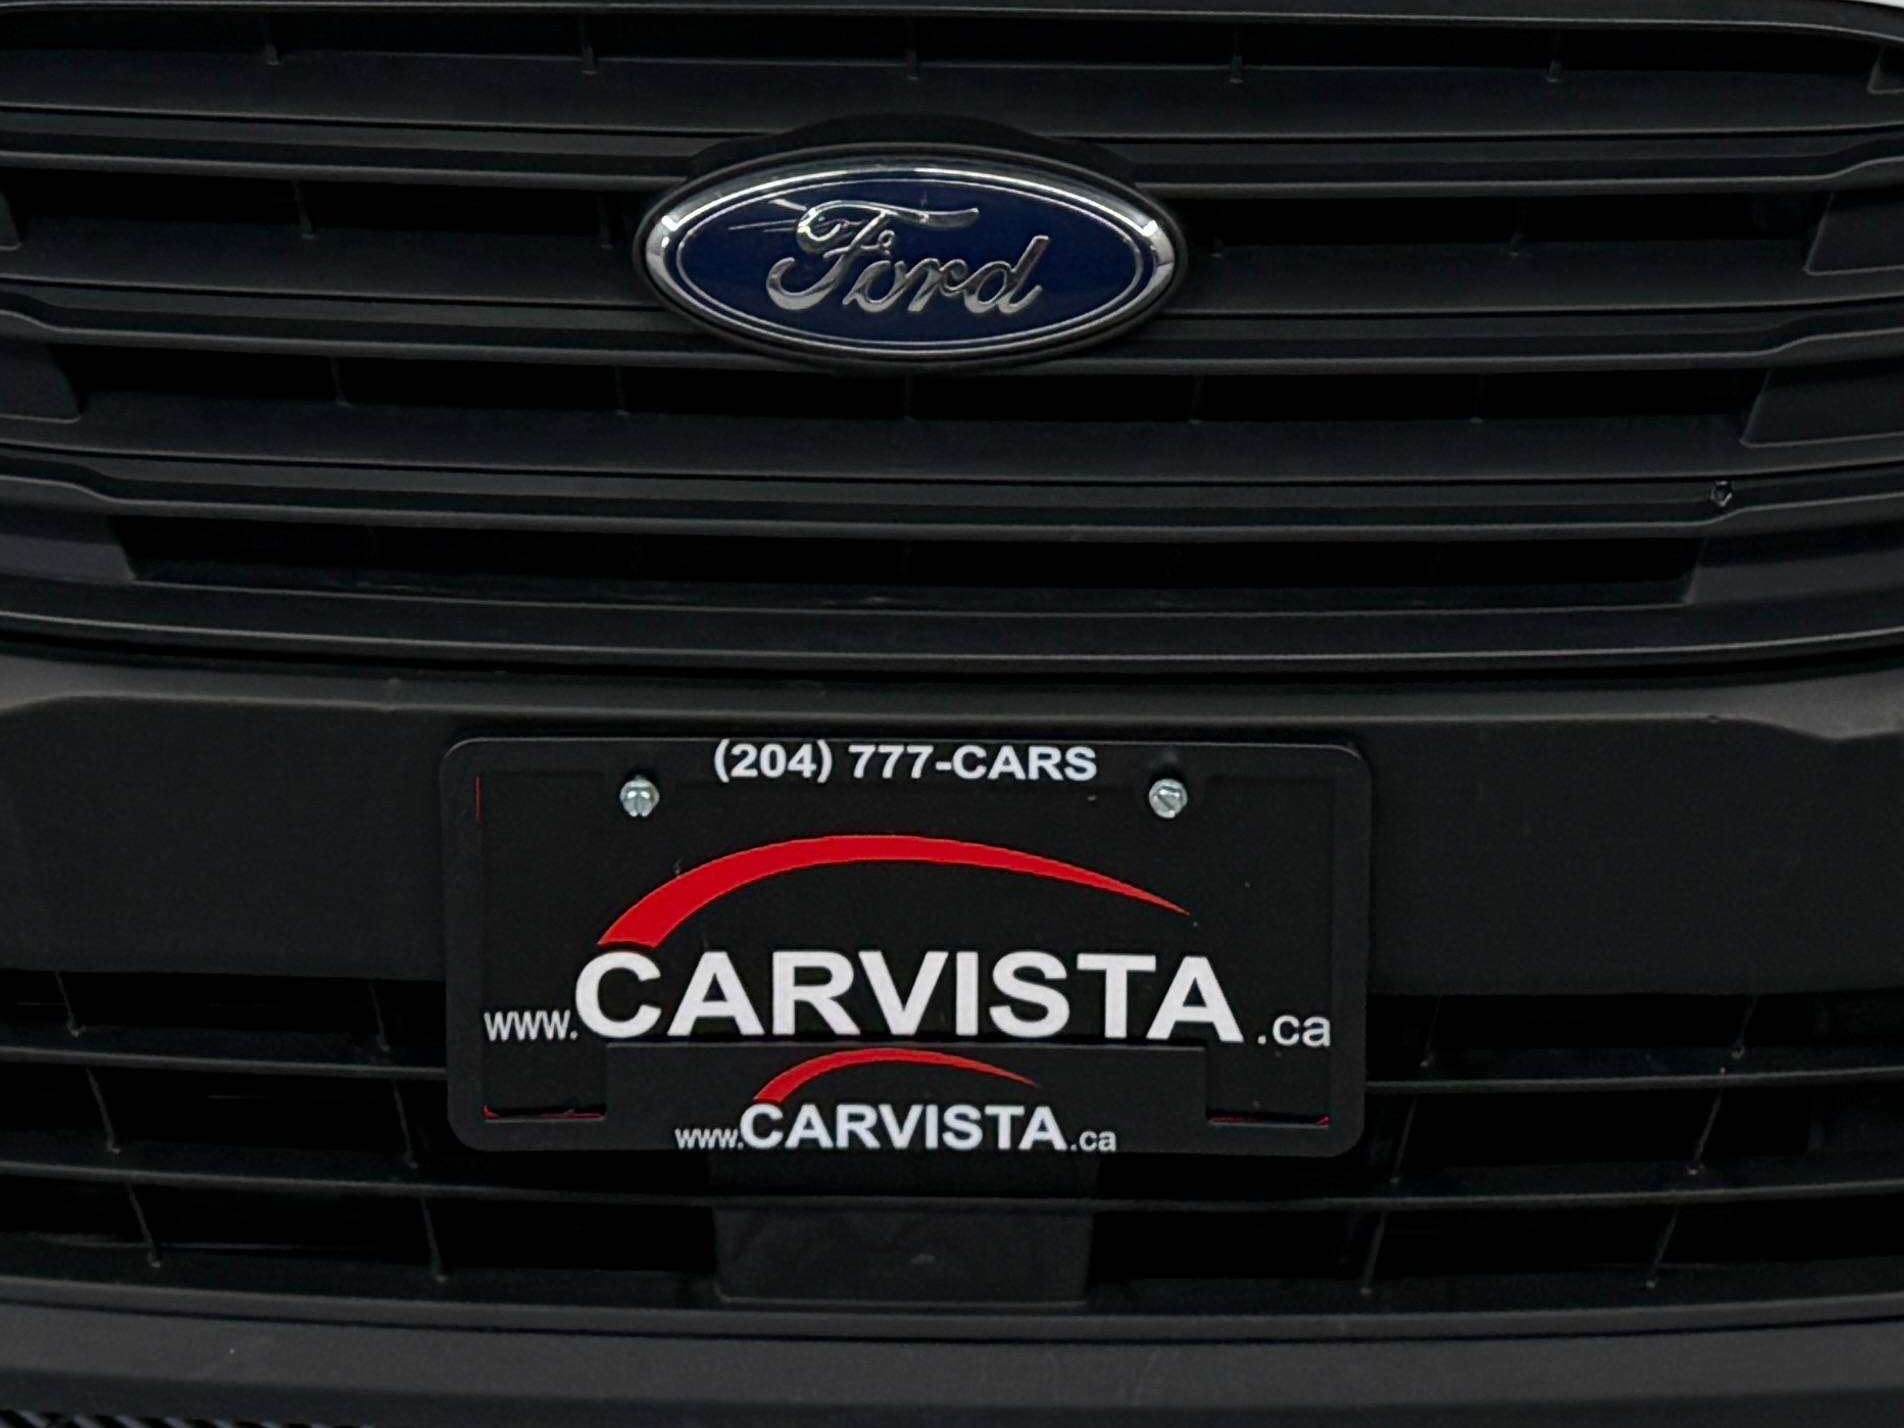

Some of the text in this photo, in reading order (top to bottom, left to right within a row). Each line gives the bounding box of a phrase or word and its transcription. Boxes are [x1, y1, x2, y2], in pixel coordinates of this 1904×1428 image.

[765, 199, 1050, 314] Ford
[713, 740, 1097, 783] (204) 777-CARS
